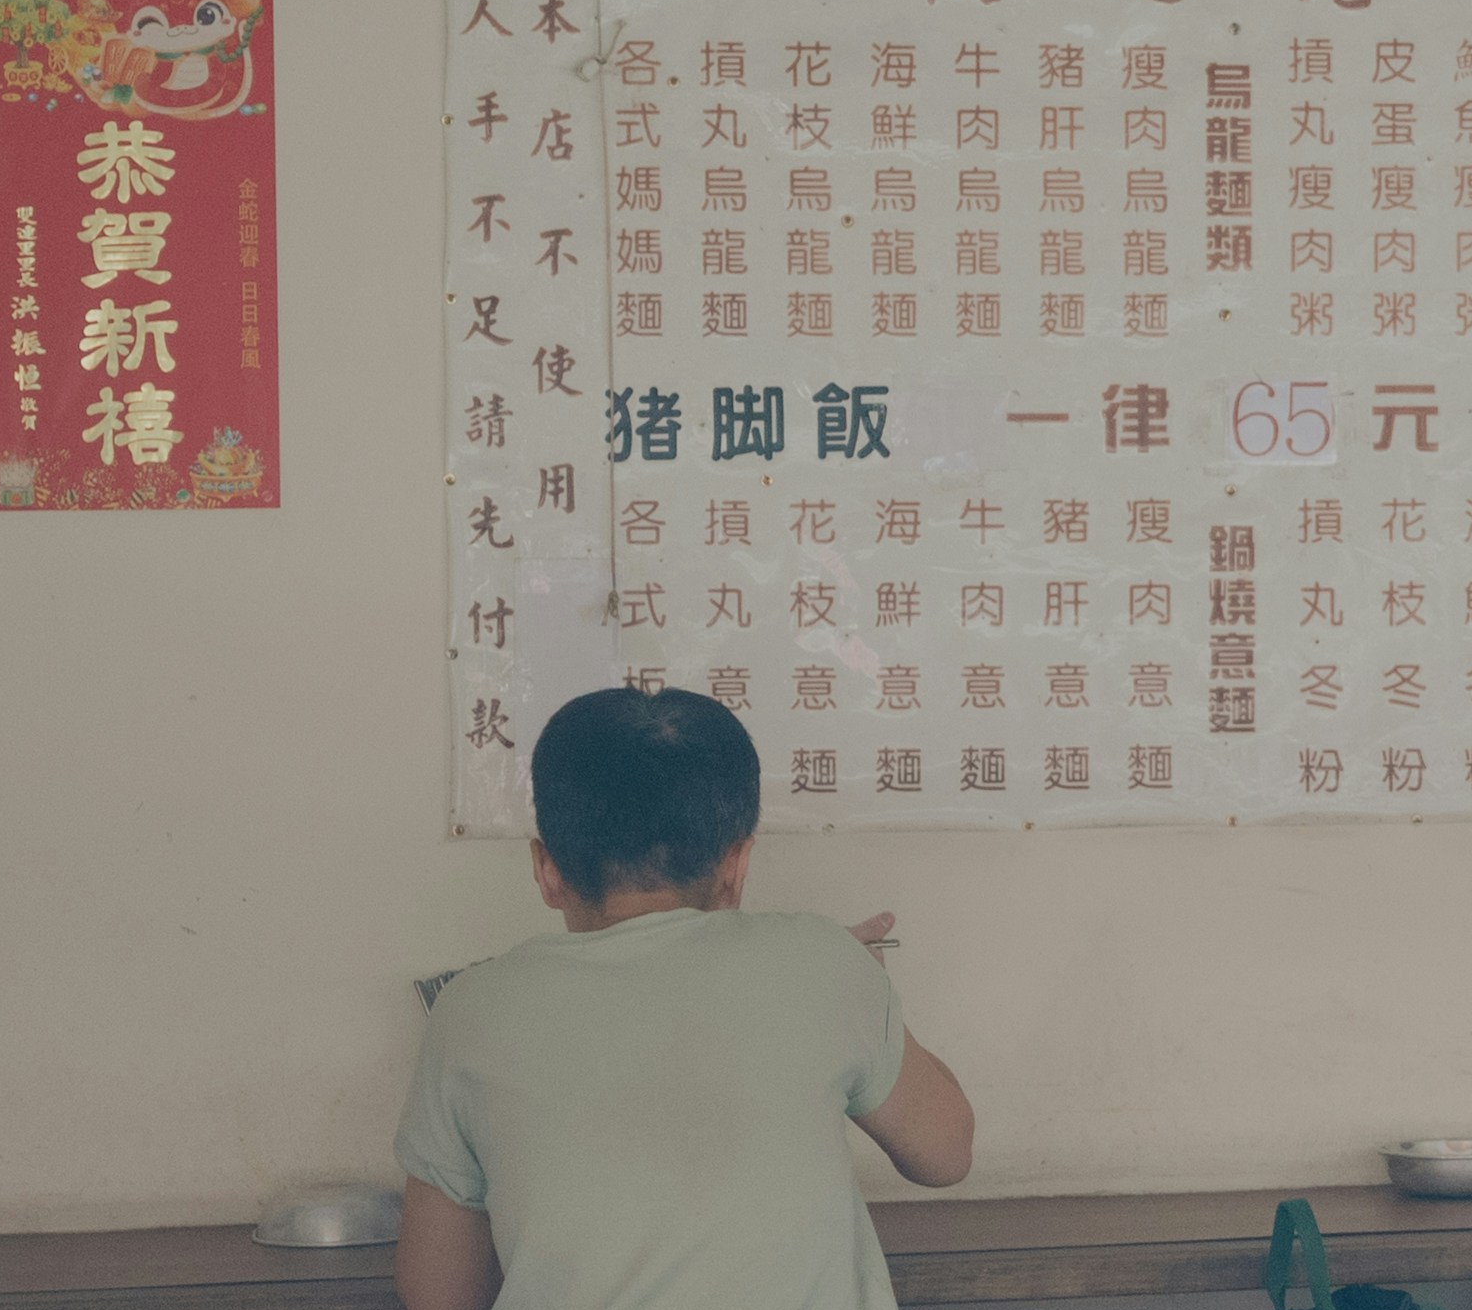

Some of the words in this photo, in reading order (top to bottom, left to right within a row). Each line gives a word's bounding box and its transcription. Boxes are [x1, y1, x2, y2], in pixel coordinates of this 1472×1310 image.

[237, 177, 262, 267] 金蛇迎春
[1373, 39, 1415, 328] 皮蛋瘦肉粥
[76, 120, 184, 467] 恭賀新禧
[239, 280, 263, 370] 日日春風
[706, 500, 751, 711] 摃丸意
[1209, 525, 1256, 733] 鍋燒意麵
[1383, 499, 1426, 792] 花枝冬粉
